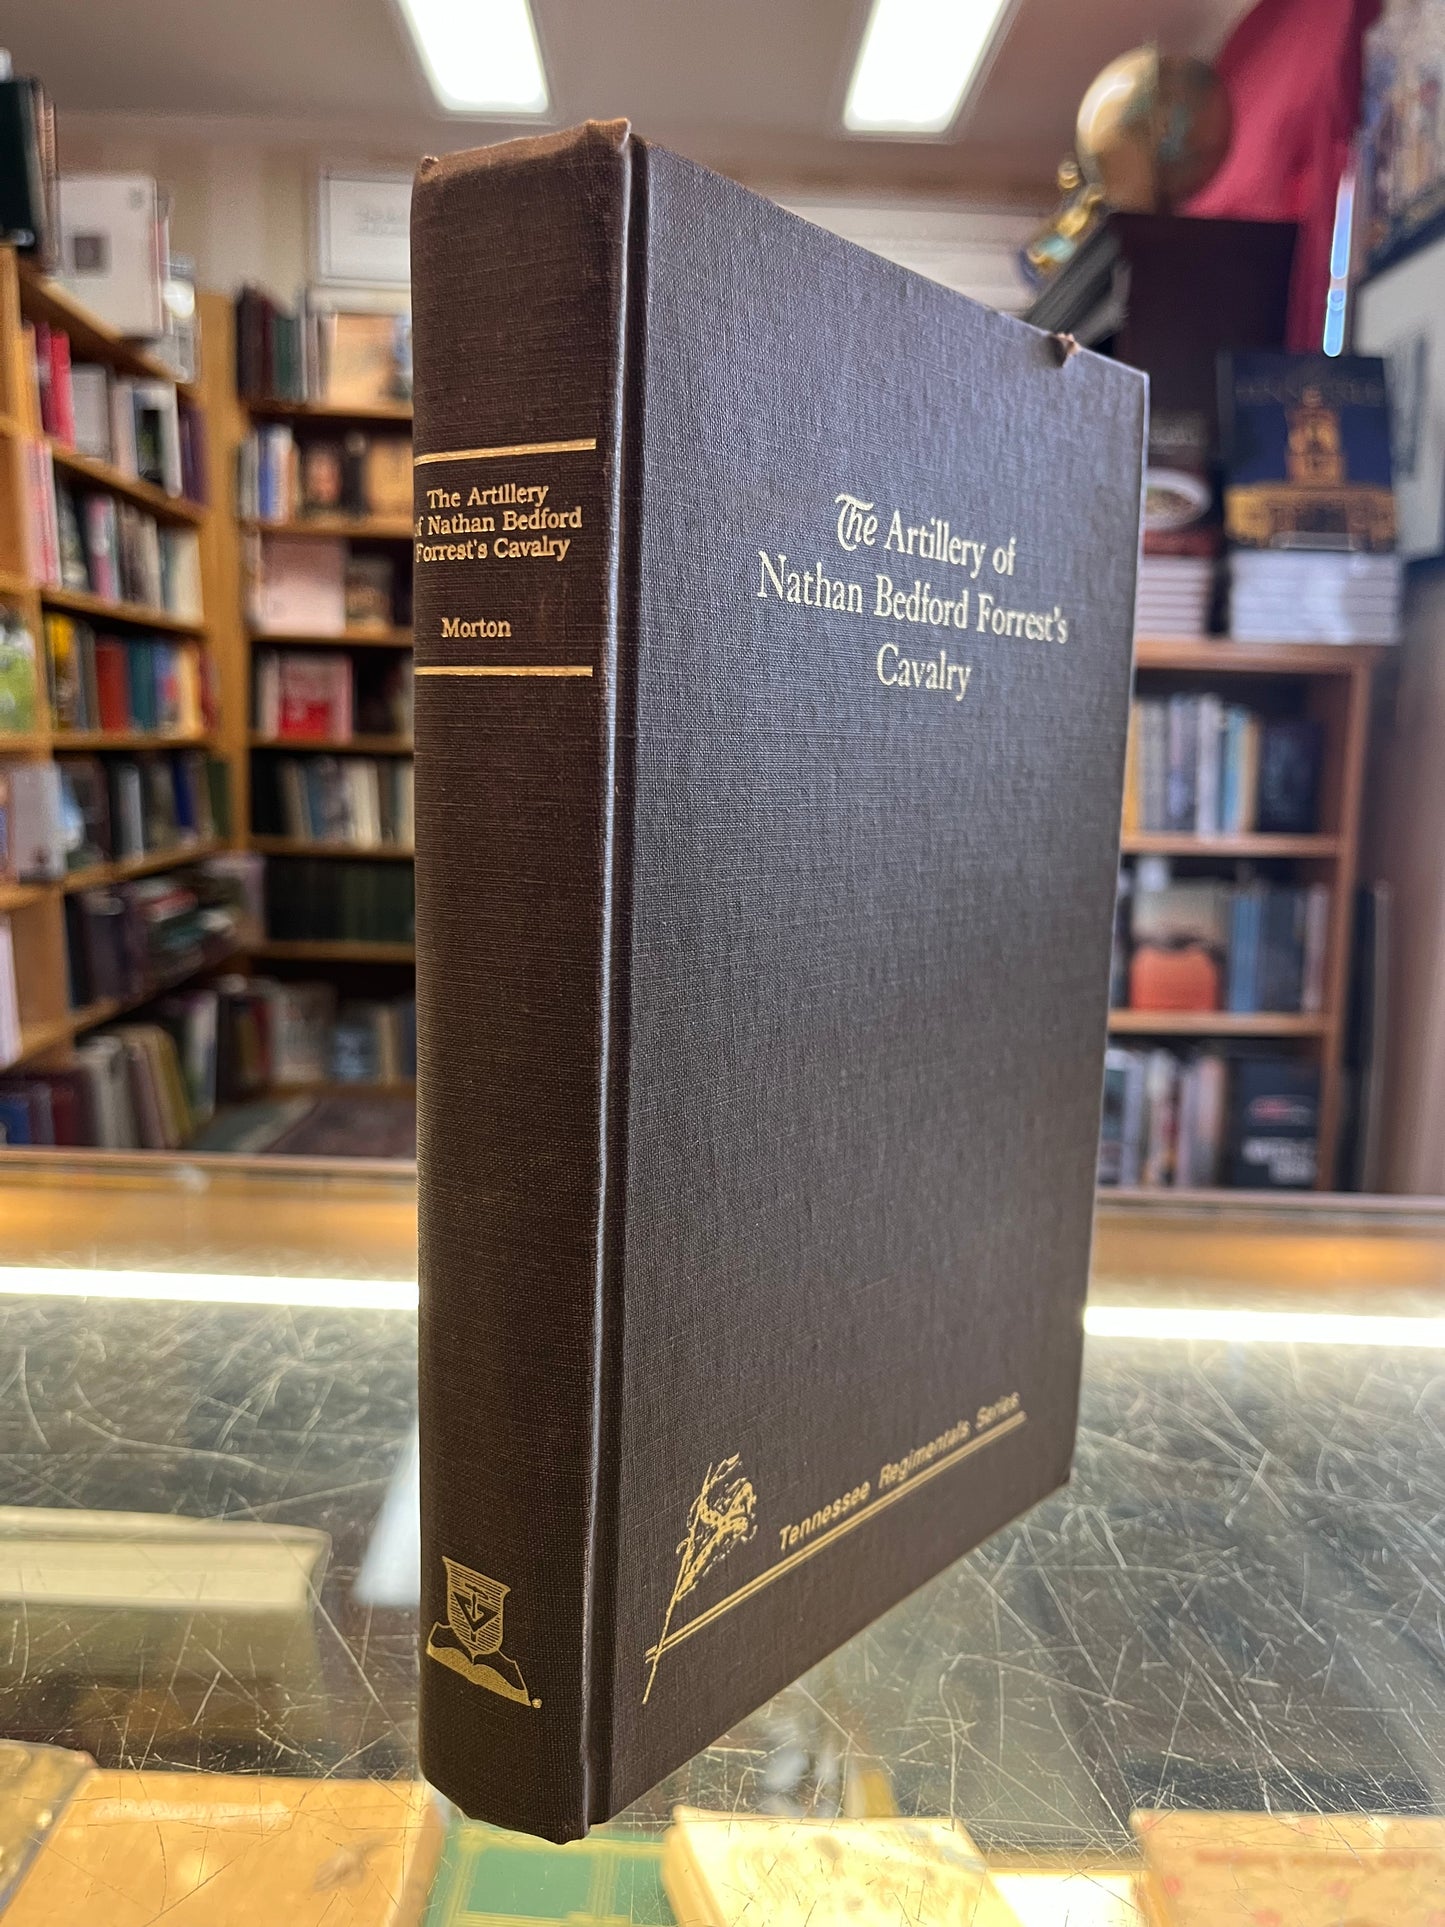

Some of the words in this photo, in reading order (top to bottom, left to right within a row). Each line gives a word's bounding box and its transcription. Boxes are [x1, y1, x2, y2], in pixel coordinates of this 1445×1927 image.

[427, 488, 460, 508] The
[467, 483, 549, 507] Artillery
[428, 514, 495, 536] Nathan
[502, 506, 582, 531] Bedford
[834, 493, 878, 551] The
[884, 510, 986, 578] Artillery
[993, 536, 1016, 576] of
[416, 538, 488, 562] Forrest's
[493, 535, 571, 561] Cavalry
[757, 550, 863, 613] Nathan
[874, 573, 969, 629] Bedford
[976, 592, 1068, 644] Forrest's
[441, 616, 512, 638] Morton
[876, 642, 971, 702] Cavalry
[779, 1480, 871, 1551] Tennessee
[878, 1419, 971, 1489] Regimentals
